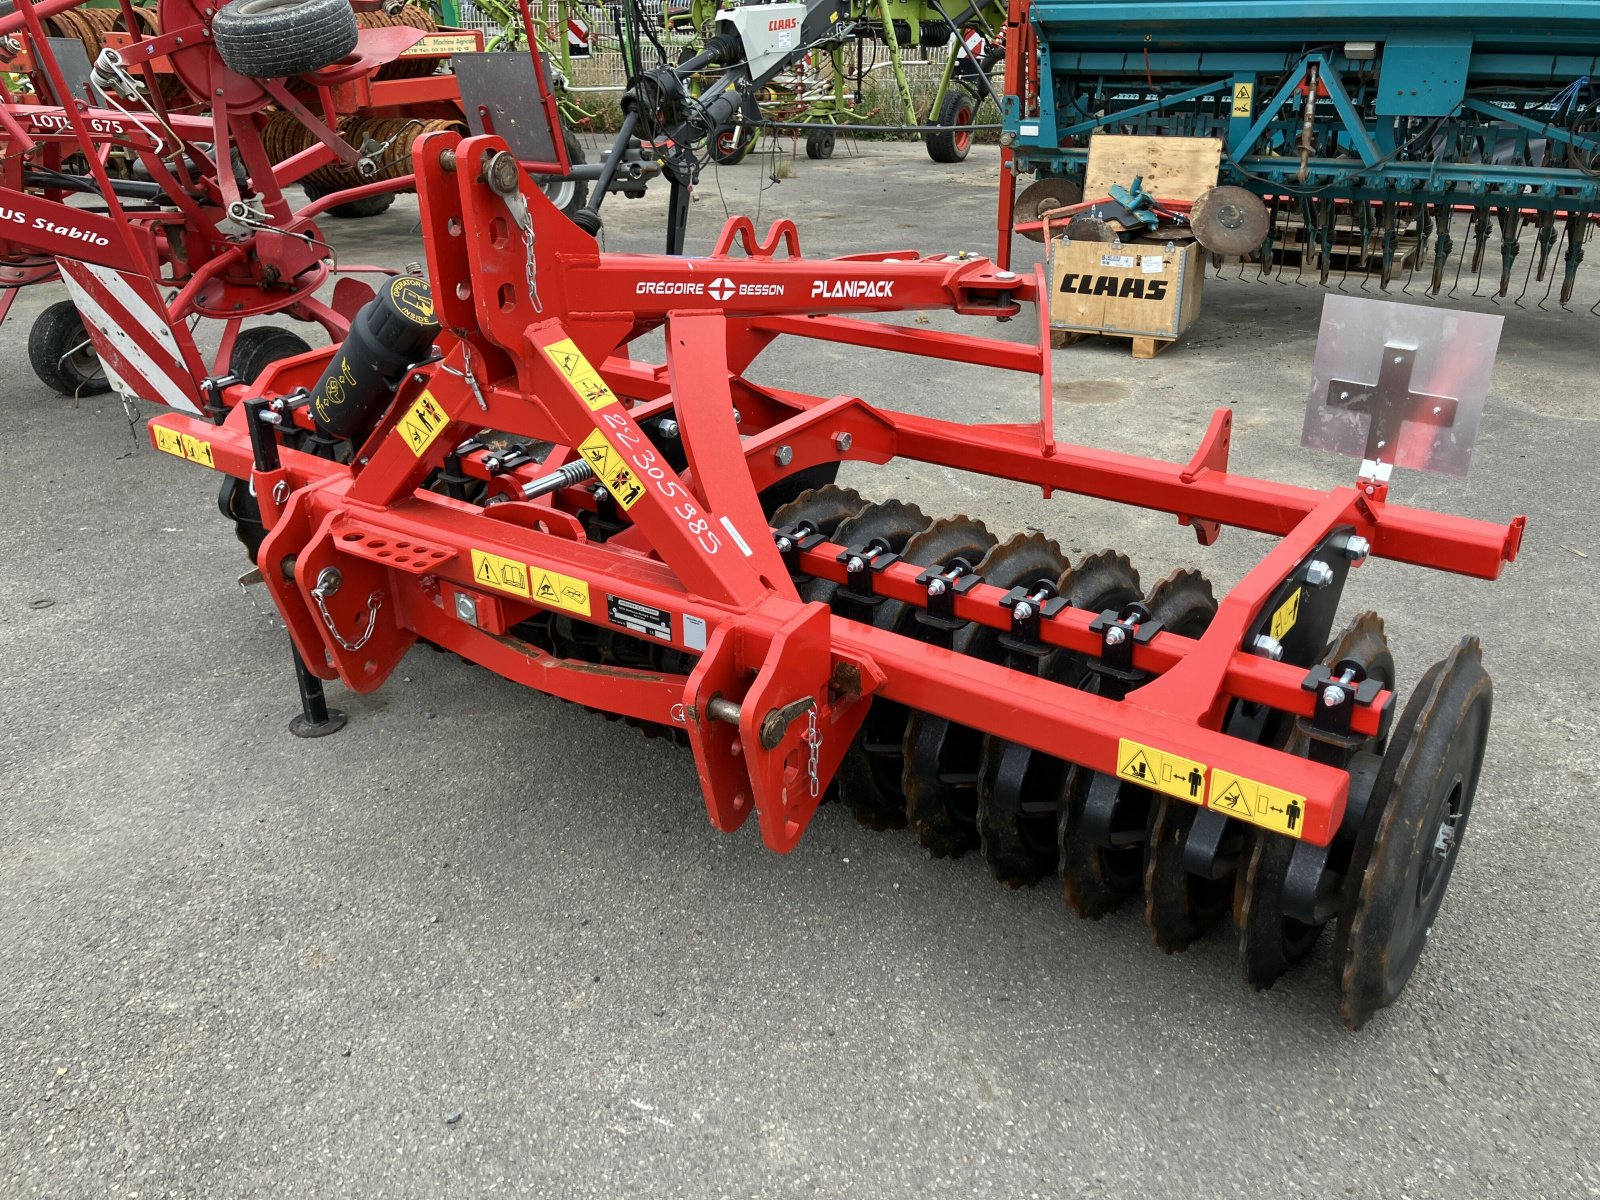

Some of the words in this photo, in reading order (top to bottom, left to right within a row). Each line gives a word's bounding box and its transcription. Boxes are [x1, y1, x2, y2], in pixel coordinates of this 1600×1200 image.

[768, 17, 797, 31] CLAAS
[91, 118, 124, 134] 675
[32, 218, 109, 246] Stabilo
[393, 279, 428, 297] OPERATOR'S
[635, 281, 705, 295] GRÉGOIRE
[739, 284, 784, 296] BESSON
[811, 280, 895, 298] PLANIPACK
[1060, 273, 1168, 300] CLAAS
[402, 307, 430, 323] INSIDE
